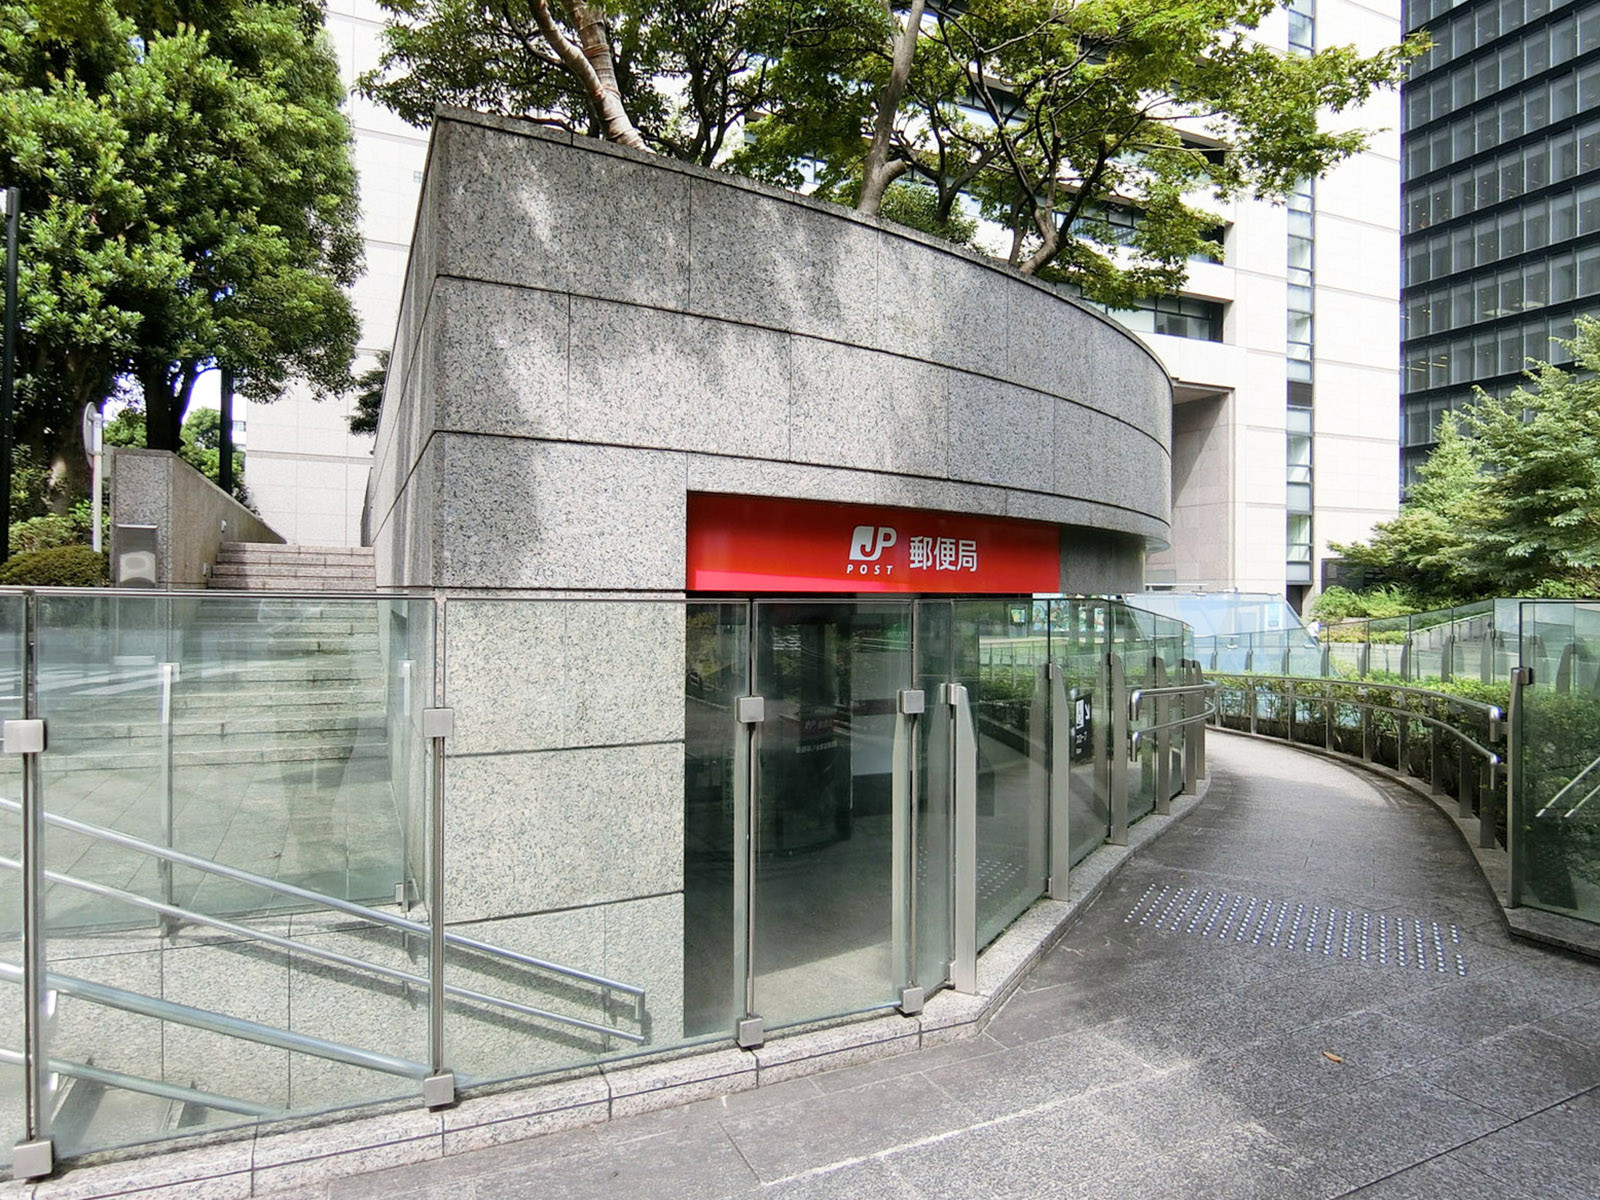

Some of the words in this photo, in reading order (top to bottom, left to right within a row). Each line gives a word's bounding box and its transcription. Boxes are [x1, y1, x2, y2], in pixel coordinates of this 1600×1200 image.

[849, 525, 897, 561] JP
[909, 536, 978, 572] 郵便局
[846, 564, 893, 575] POST
